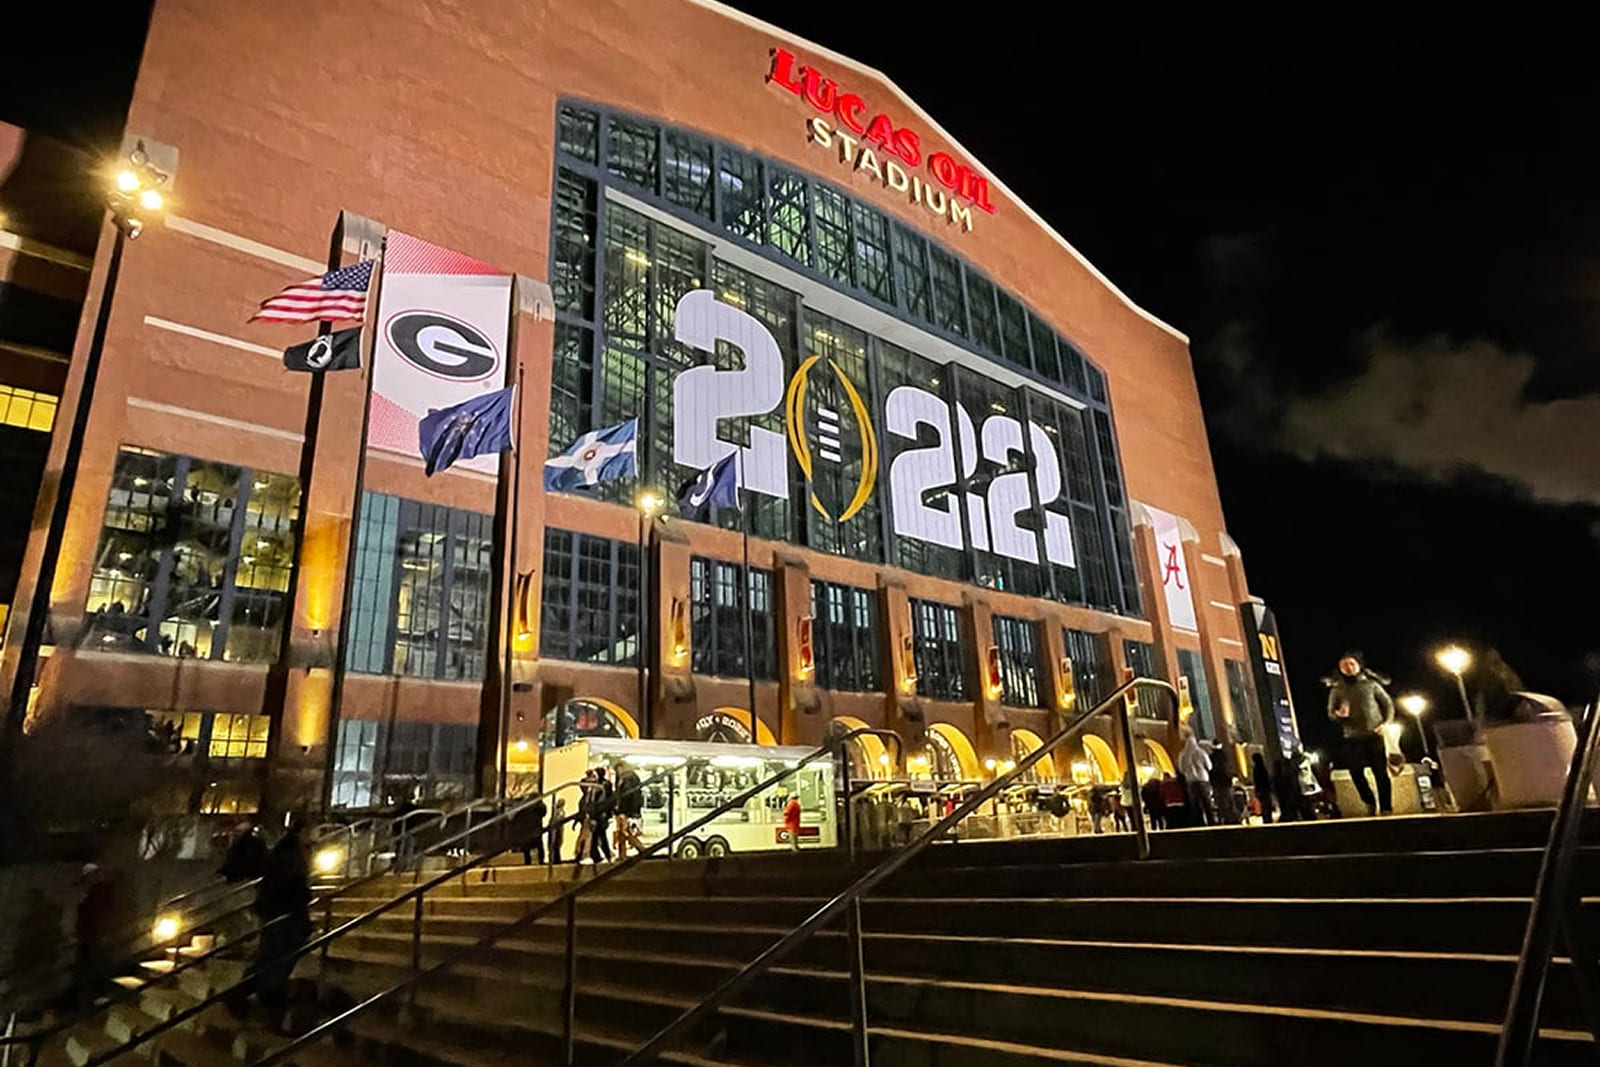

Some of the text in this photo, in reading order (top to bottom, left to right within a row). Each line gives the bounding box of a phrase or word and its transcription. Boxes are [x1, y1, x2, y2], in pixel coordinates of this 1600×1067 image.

[769, 47, 996, 214] LUCAS OIL
[809, 116, 974, 232] STADIUM
[388, 312, 497, 381] G
[1163, 541, 1184, 590] A
[1258, 632, 1278, 662] N
